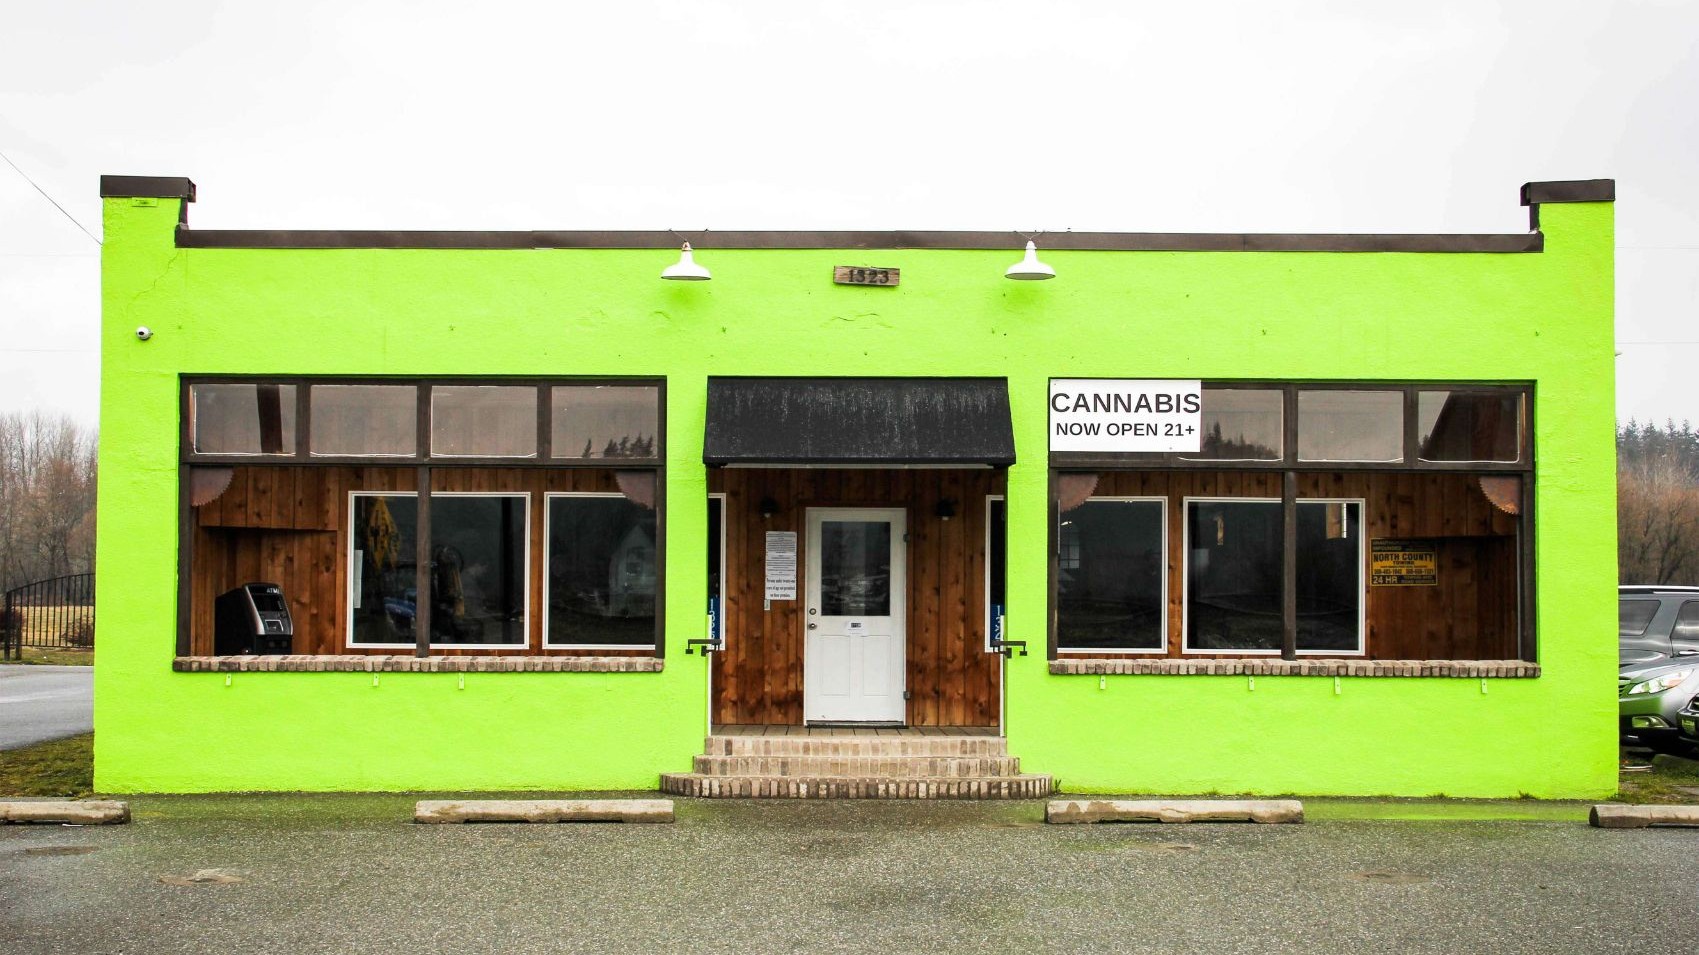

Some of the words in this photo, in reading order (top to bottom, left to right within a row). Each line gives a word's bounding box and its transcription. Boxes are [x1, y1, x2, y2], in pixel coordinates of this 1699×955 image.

[848, 269, 889, 284] 1323
[1051, 392, 1201, 414] CANNABIS
[1056, 422, 1101, 436] NOW
[1106, 423, 1158, 437] OPEN
[1164, 423, 1195, 437] 21+
[1373, 553, 1400, 562] NORTH
[1402, 553, 1433, 562] COUNTY
[1373, 576, 1384, 584] 24
[1385, 576, 1398, 584] HR
